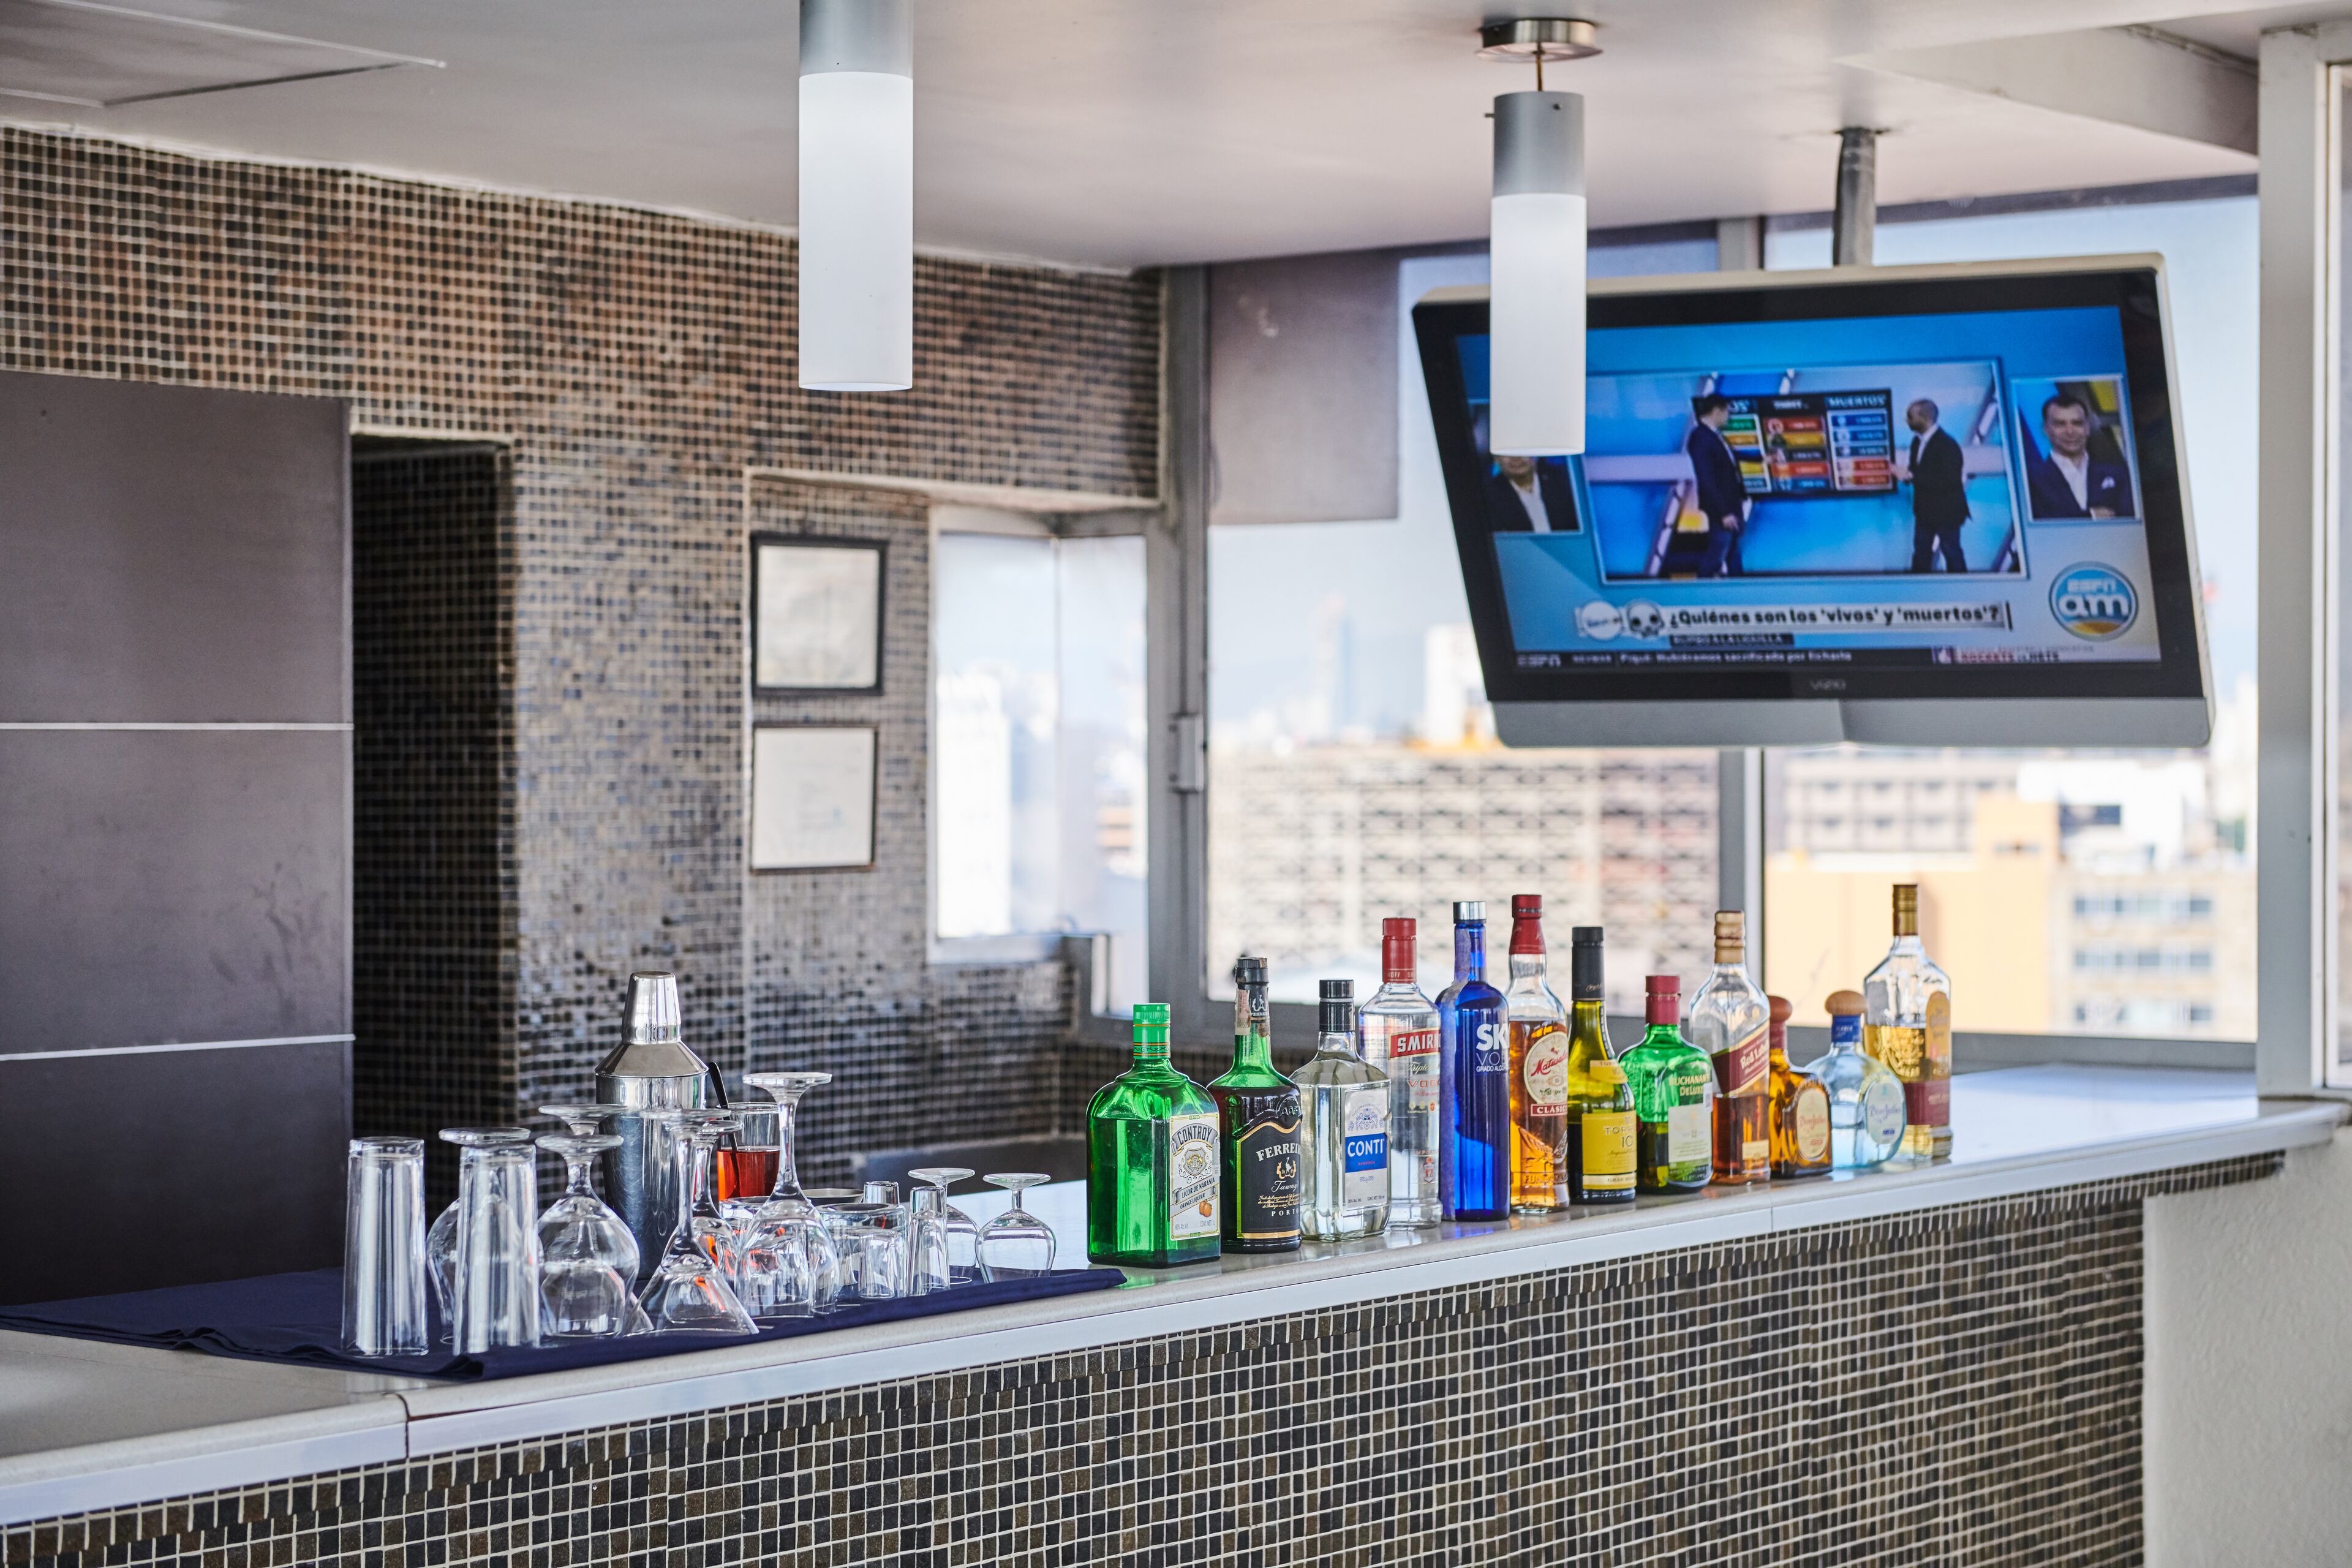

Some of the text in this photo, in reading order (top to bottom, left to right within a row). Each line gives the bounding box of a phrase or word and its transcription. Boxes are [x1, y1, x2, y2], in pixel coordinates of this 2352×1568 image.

[2066, 578, 2116, 593] ESPN
[2058, 593, 2130, 617] am
[1670, 604, 1999, 628] ¿Quiénes son los 'vivos' y 'muertos'?
[1397, 1033, 1441, 1053] SMIRN
[1476, 1023, 1510, 1051] SK
[1531, 1050, 1568, 1077] Matusal
[1740, 1051, 1755, 1069] Red
[1537, 1105, 1567, 1114] CLÁSIC
[1177, 1125, 1213, 1145] CONTROY
[1621, 1135, 1634, 1147] 10
[1348, 1138, 1383, 1158] CONTI
[1182, 1188, 1194, 1199] LICOR
[1199, 1177, 1215, 1191] NARANJA
[1271, 1180, 1299, 1193] Tawny
[1180, 1200, 1192, 1210] ORANGE
[1271, 1208, 1299, 1216] PORTO
